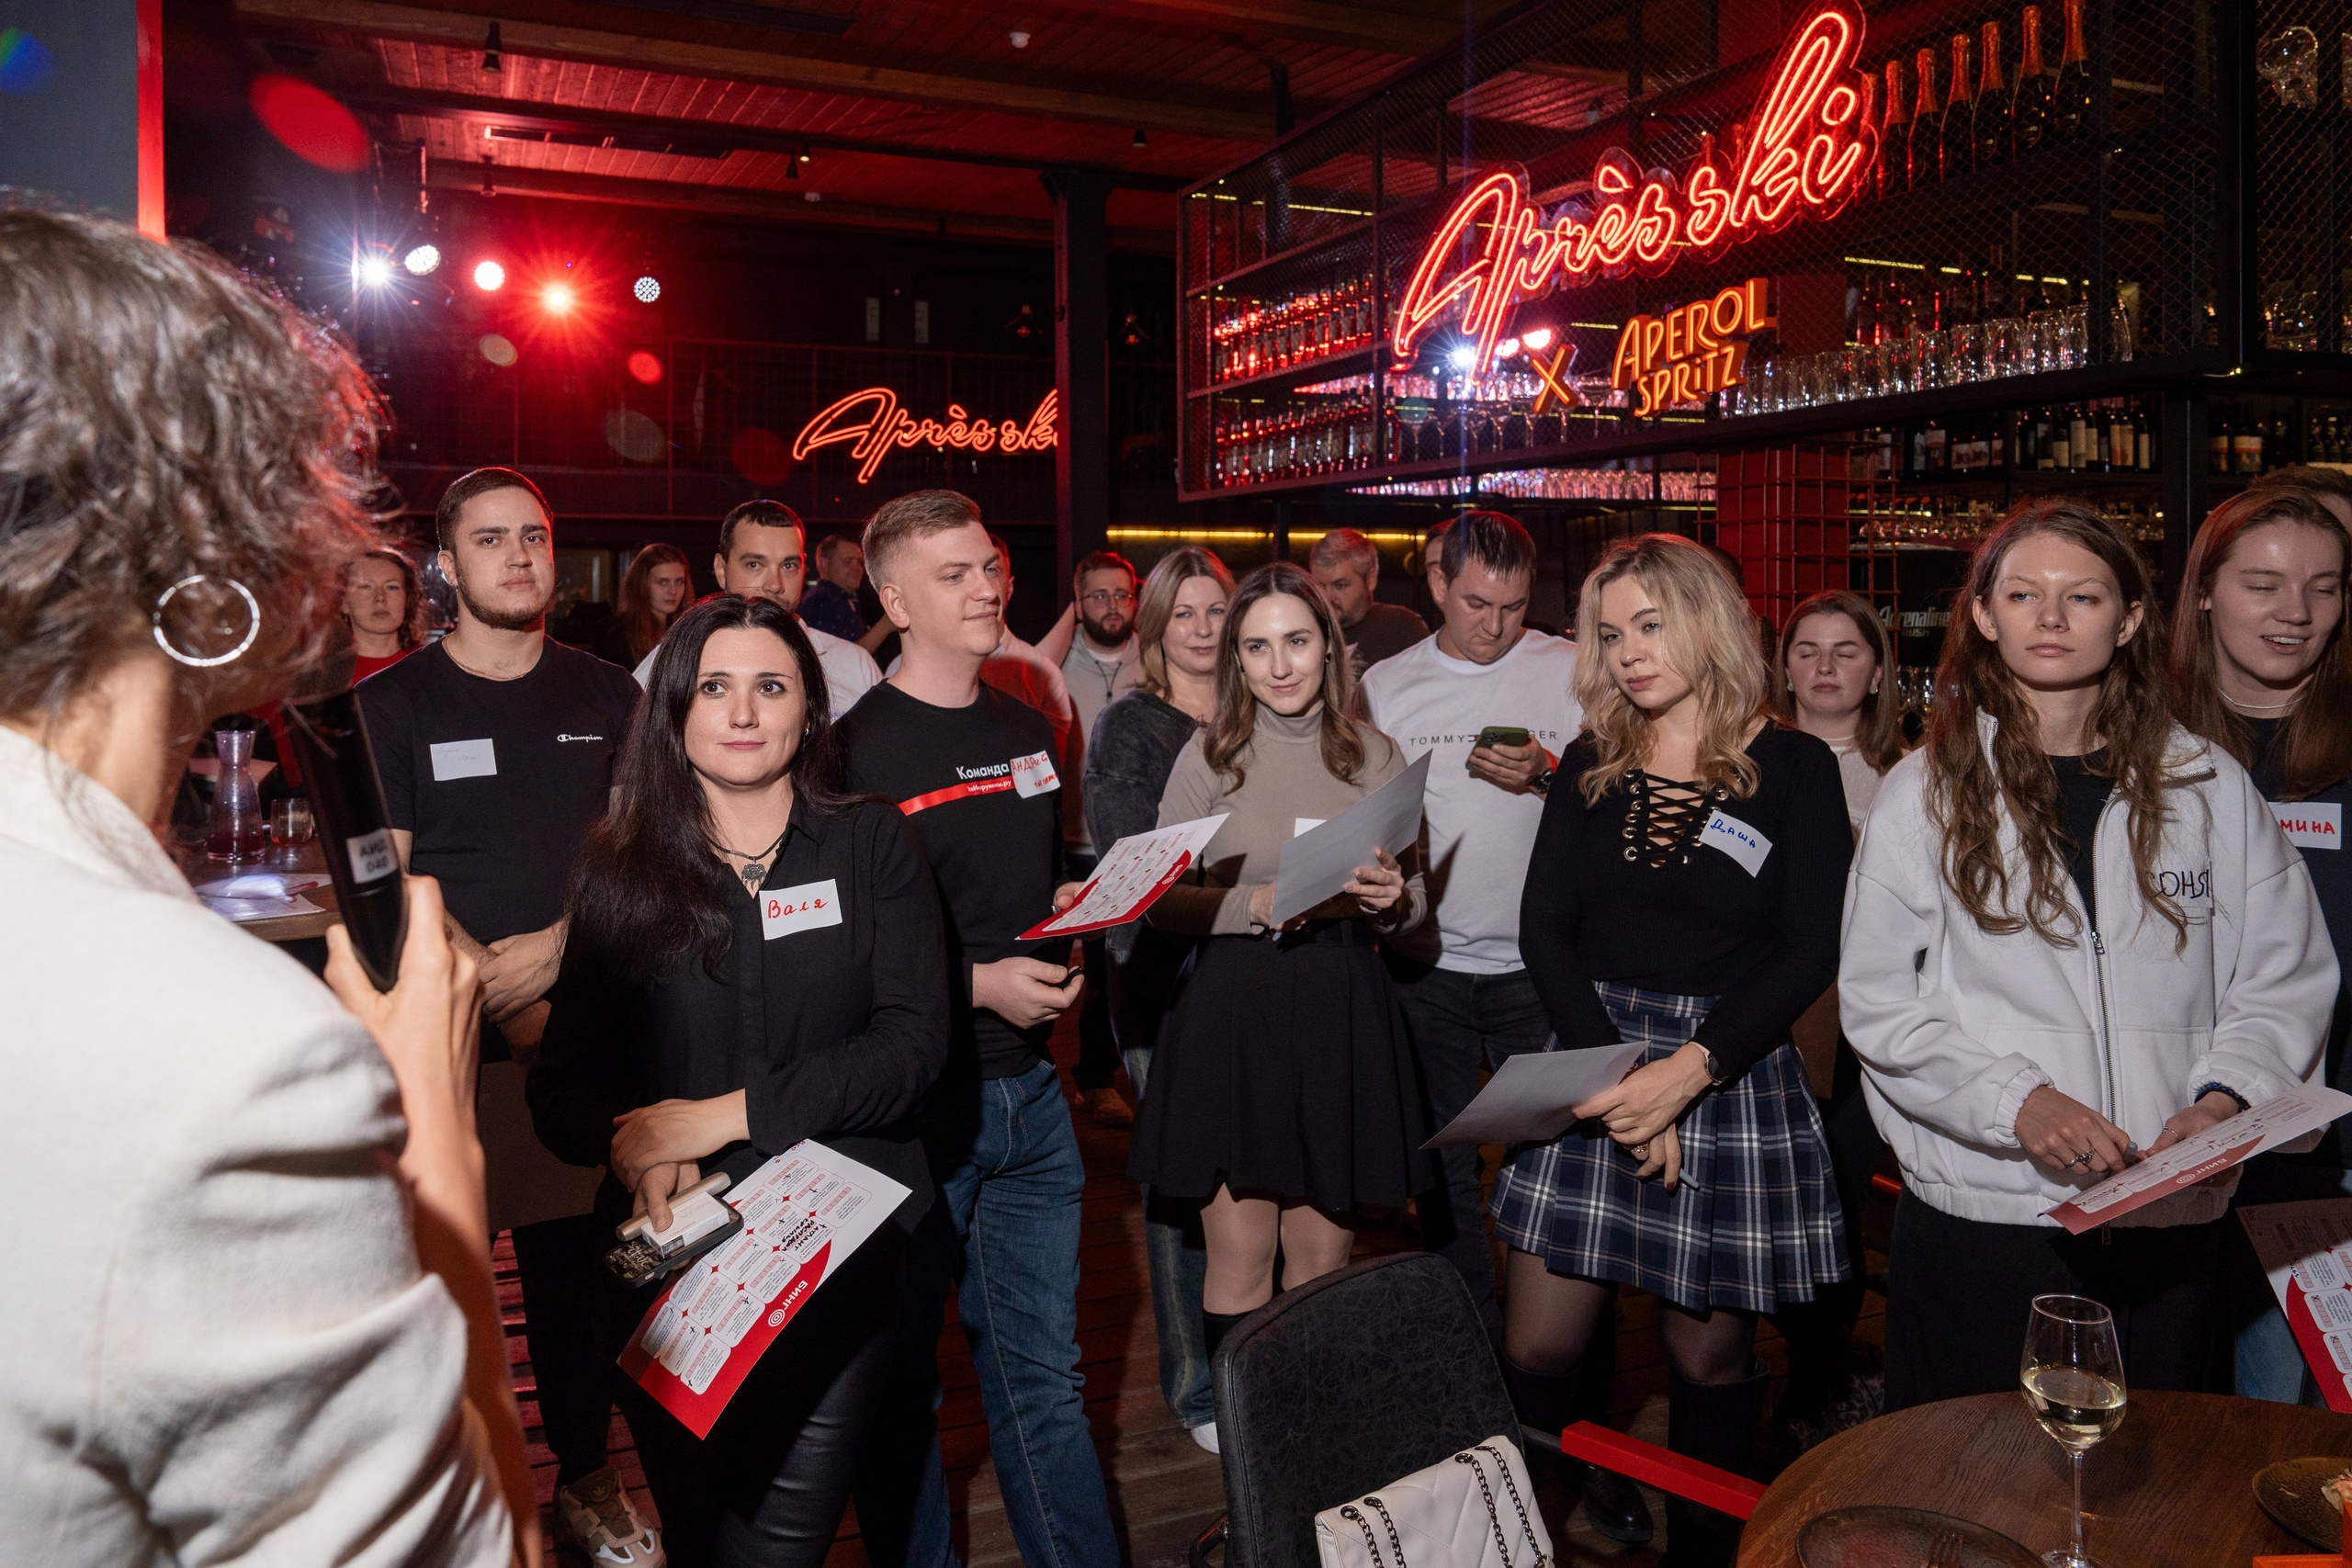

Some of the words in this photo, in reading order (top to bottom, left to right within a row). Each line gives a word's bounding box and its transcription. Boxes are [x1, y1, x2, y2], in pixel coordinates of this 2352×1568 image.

[1611, 277, 1772, 390] APEROL
[999, 389, 1057, 452] sk
[557, 733, 603, 742] Champion
[1409, 735, 1465, 746] TOMMY
[956, 762, 1010, 780] Команда
[2154, 869, 2210, 898] ОНЯ
